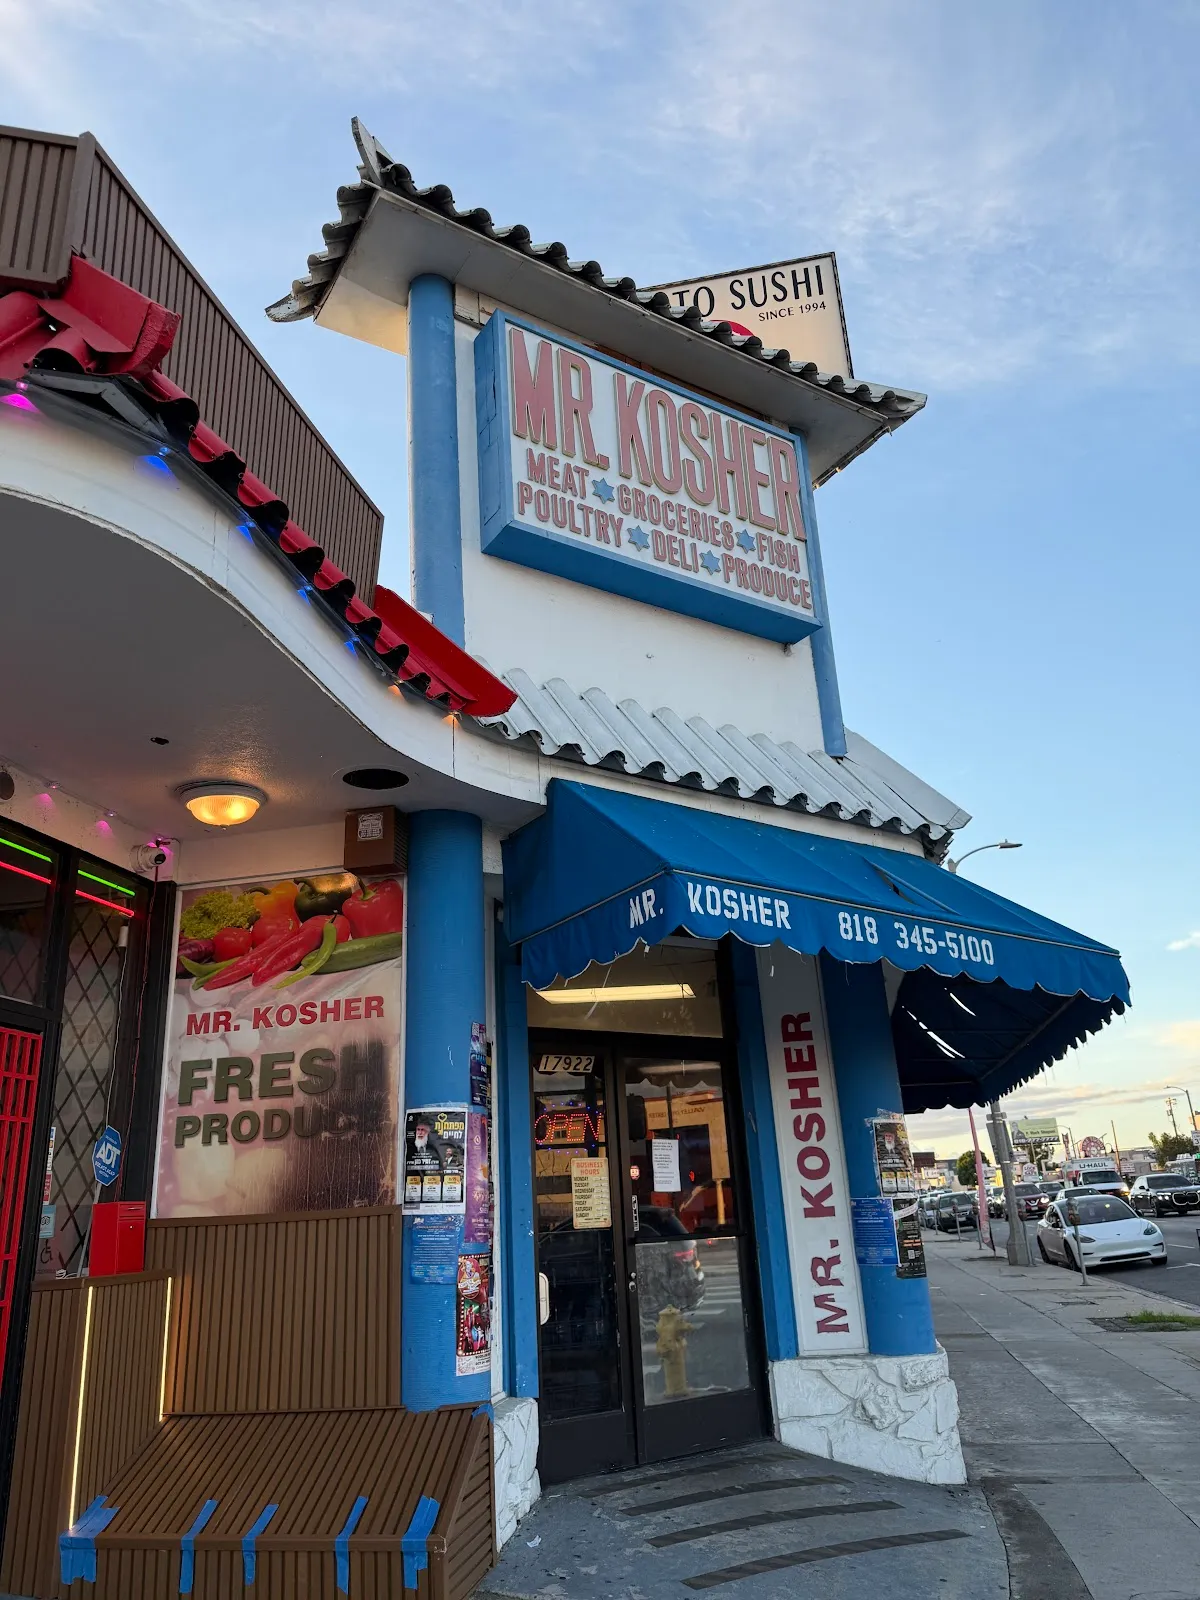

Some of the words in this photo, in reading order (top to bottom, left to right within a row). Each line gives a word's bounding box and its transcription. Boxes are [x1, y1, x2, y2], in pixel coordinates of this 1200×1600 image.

[729, 265, 824, 310] SUSHI
[758, 307, 794, 322] SINCE
[799, 301, 827, 315] 1994
[509, 327, 610, 471] MR.
[613, 372, 806, 542] KOSHER
[526, 448, 589, 499] MEAT
[617, 484, 735, 551] GROCERIES
[755, 532, 800, 574] FISH
[517, 481, 624, 548] POULTRY
[652, 529, 700, 573] DELI
[722, 552, 813, 610] PRODUCE
[630, 888, 664, 929] MR.
[687, 882, 792, 930] KOSHER
[838, 911, 879, 945] 818
[893, 921, 995, 966] 345-5100
[186, 1010, 241, 1036] MR.
[252, 995, 385, 1030] KOSHER
[178, 1040, 387, 1105] FRESH
[543, 1055, 593, 1072] 17922
[443, 1130, 463, 1139] לחיים
[534, 1112, 602, 1144] OPEN
[781, 1011, 836, 1218] KOSHER
[96, 1141, 121, 1169] ADT
[813, 1239, 850, 1334] MR.
